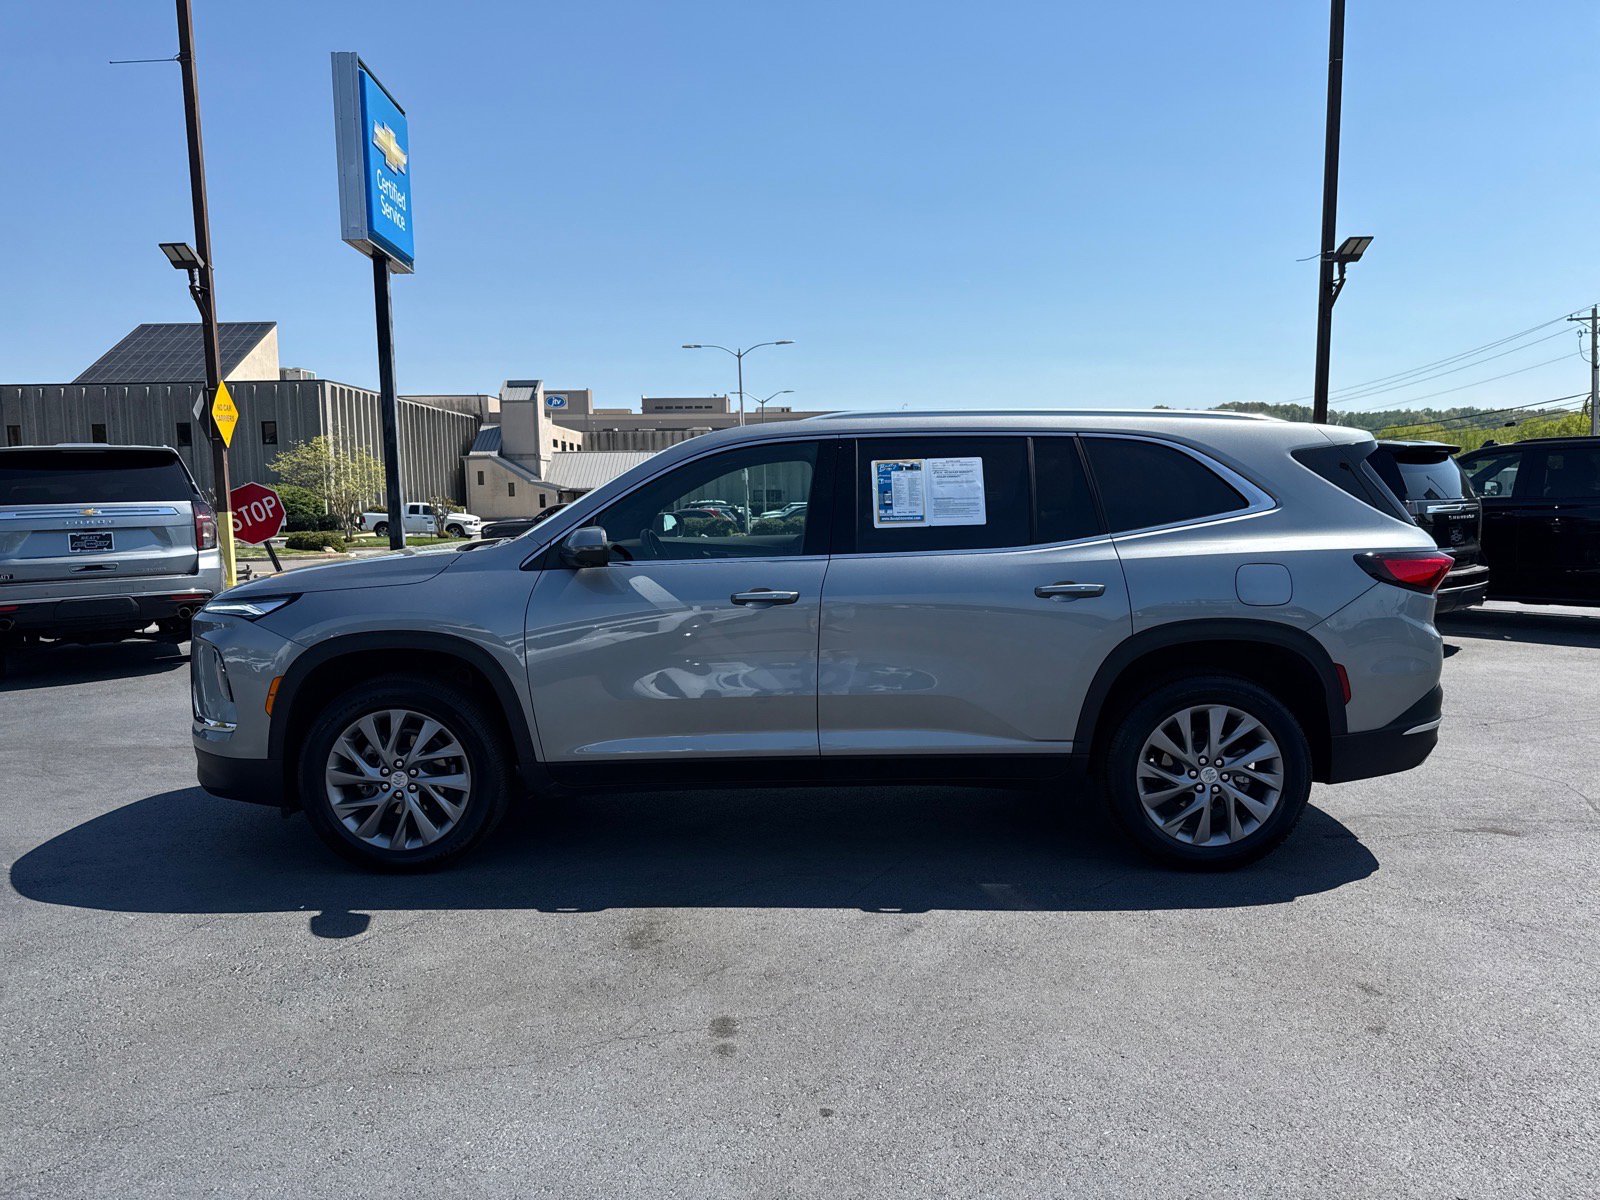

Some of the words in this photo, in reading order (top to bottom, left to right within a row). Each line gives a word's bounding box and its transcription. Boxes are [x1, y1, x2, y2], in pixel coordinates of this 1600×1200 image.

[376, 168, 406, 212] Certified
[380, 194, 406, 232] Service
[231, 495, 276, 532] STOP
